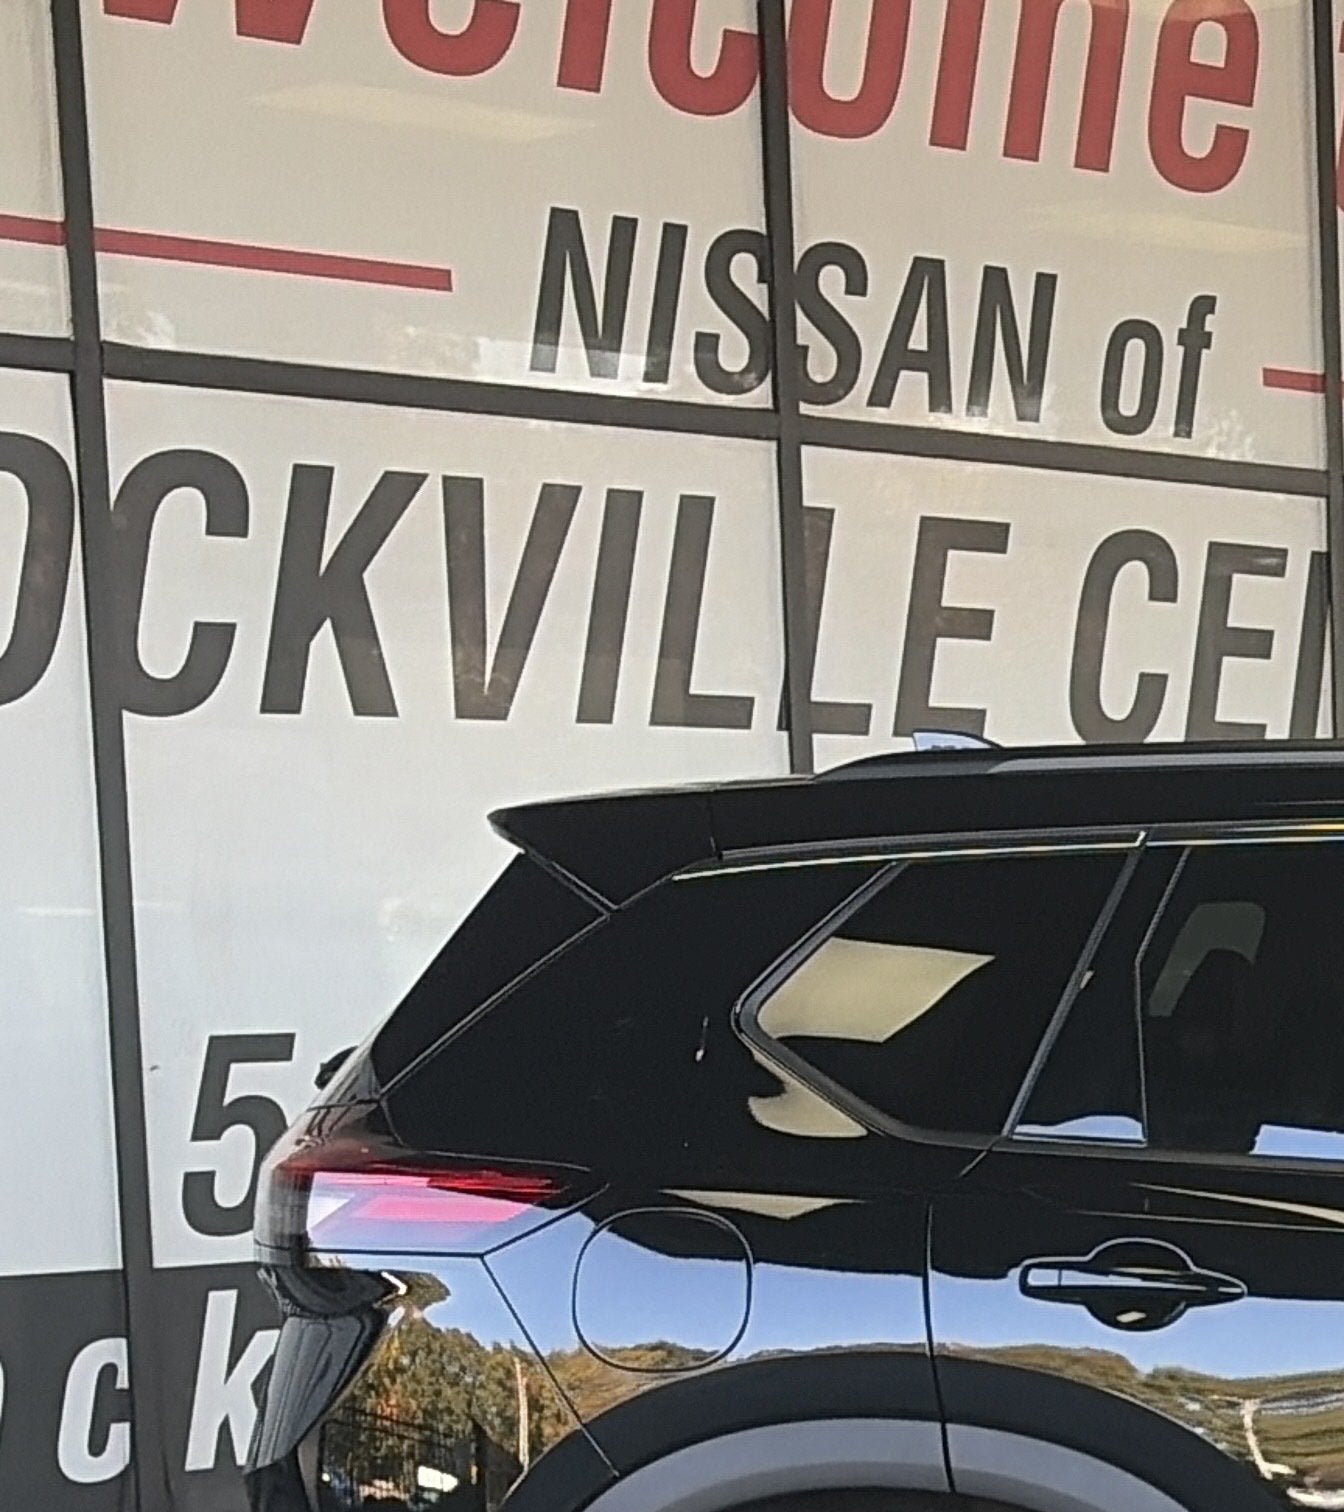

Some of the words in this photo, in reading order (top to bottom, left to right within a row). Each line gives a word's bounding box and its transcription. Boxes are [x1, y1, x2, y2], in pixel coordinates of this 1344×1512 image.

[103, 0, 1259, 192] come
[528, 206, 1059, 423] NISSAN
[1101, 294, 1218, 439] of
[181, 1033, 297, 1238] 5
